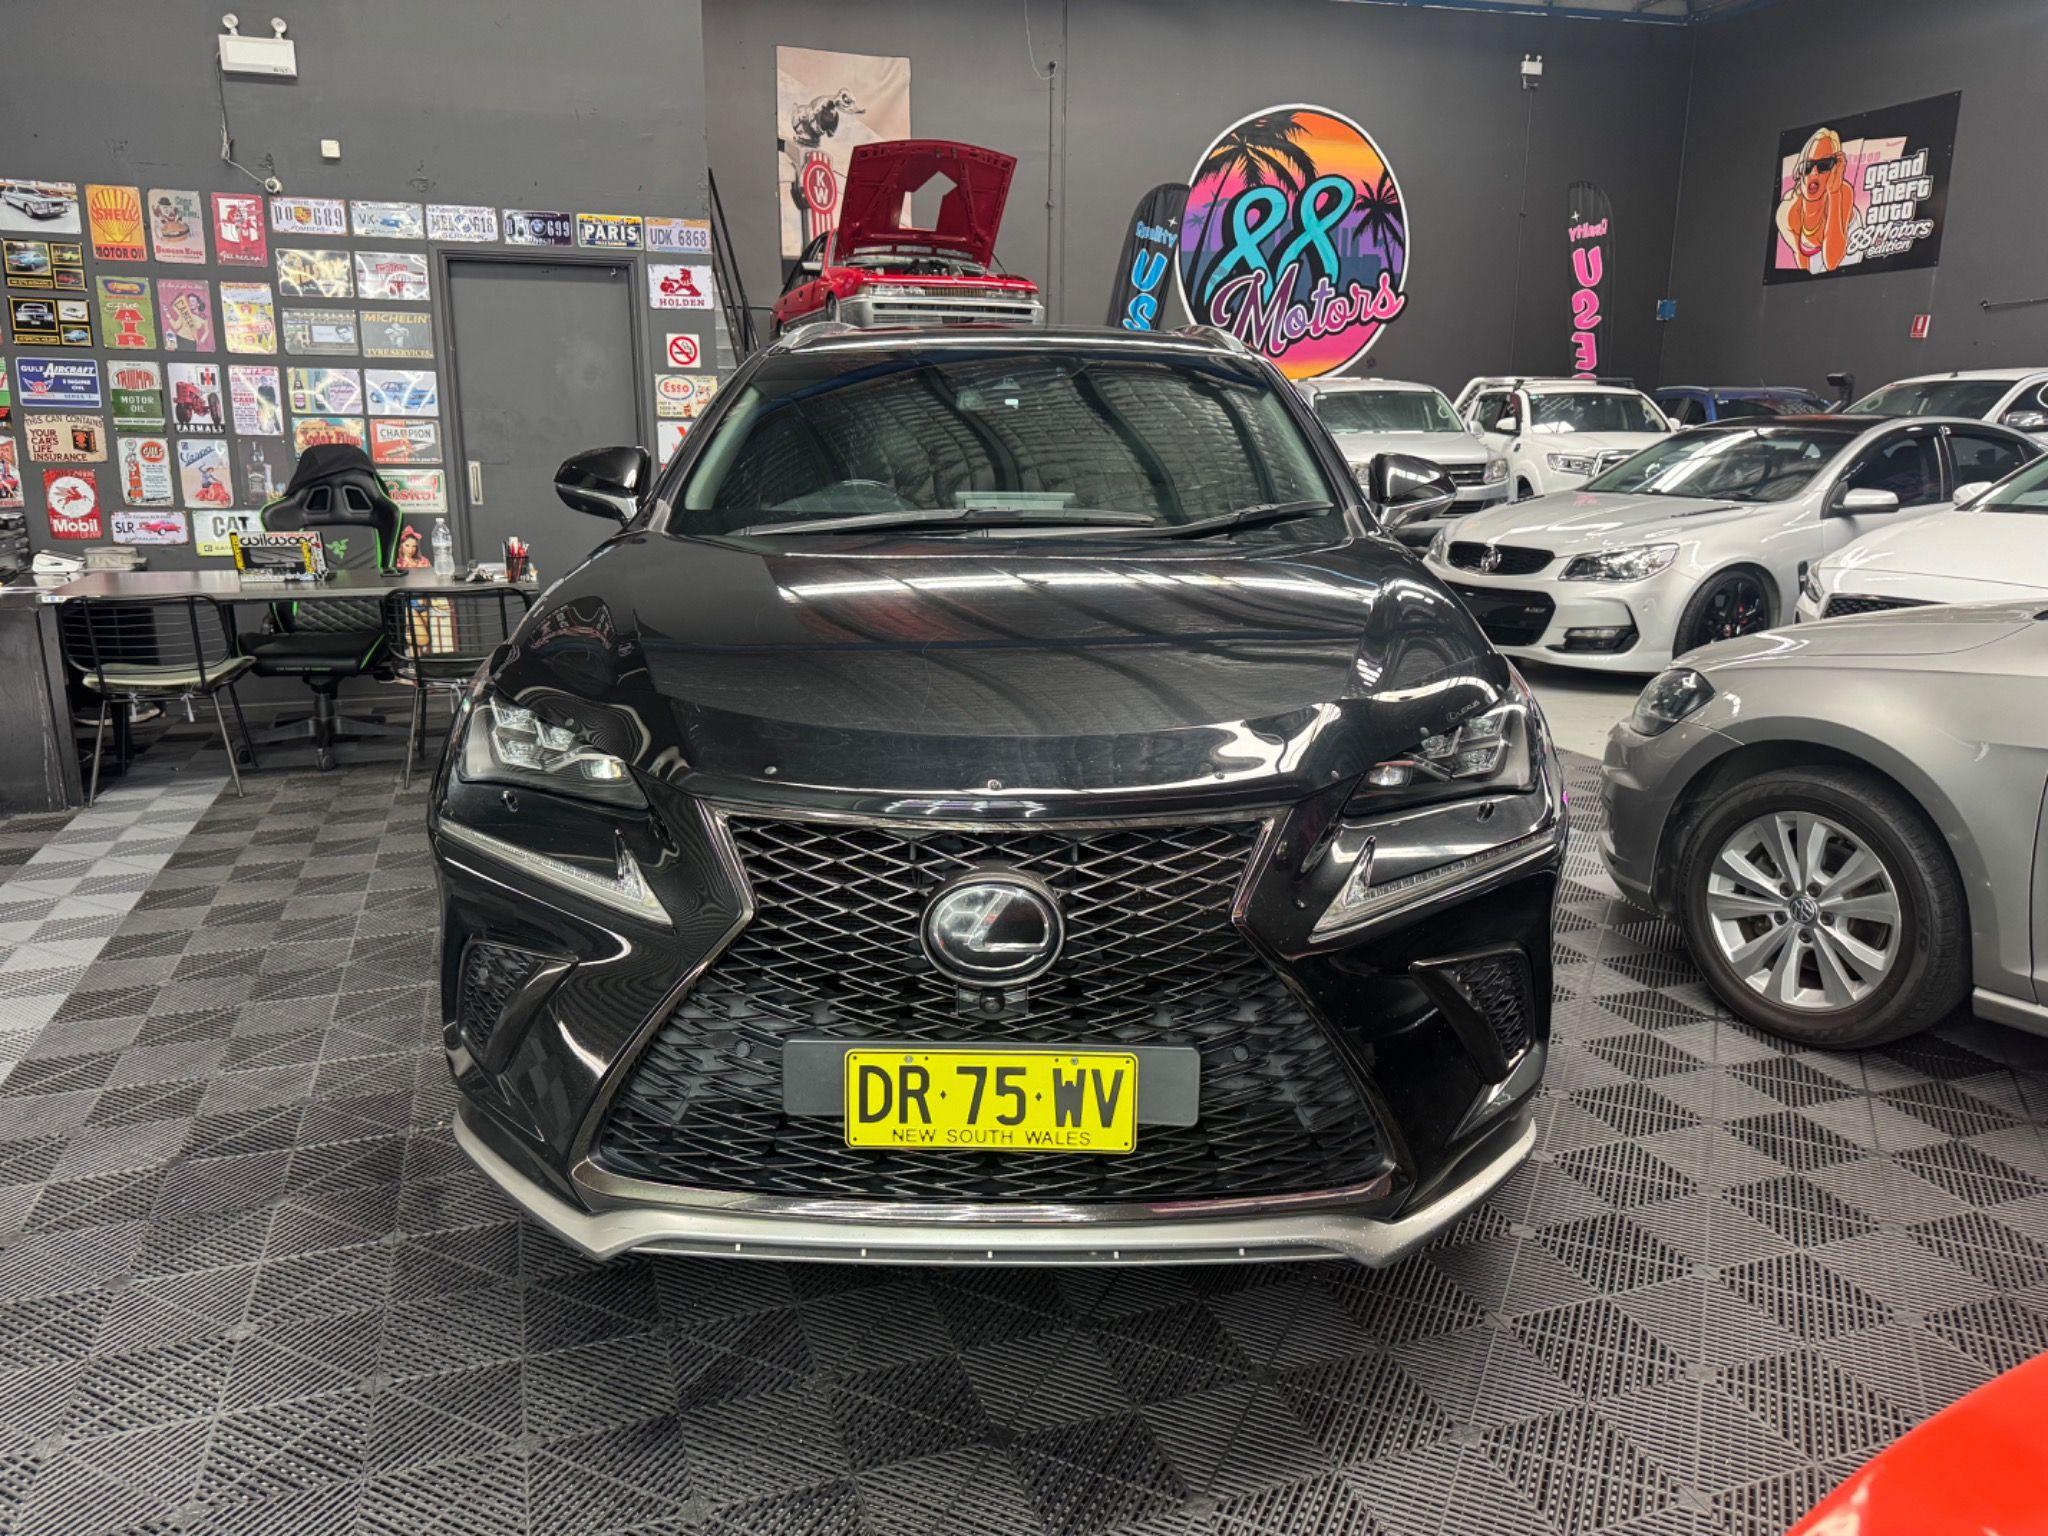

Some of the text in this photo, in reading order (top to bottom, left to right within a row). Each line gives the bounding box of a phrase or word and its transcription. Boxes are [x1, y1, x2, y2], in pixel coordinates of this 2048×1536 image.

[96, 208, 135, 220] SHELL
[313, 207, 343, 227] 689
[547, 220, 569, 237] 699
[584, 223, 637, 241] PARIS
[650, 228, 707, 247] UDK 6868
[1203, 173, 1354, 306] 88
[96, 246, 145, 259] MOTOR OIL
[1209, 262, 1403, 356] Motors
[364, 313, 428, 324] MICHELIN
[20, 363, 97, 378] GULF AIRCRAFT
[121, 396, 154, 404] MOTOR
[130, 405, 146, 413] OIL
[46, 415, 62, 423] CAN
[29, 429, 57, 438] YOUR
[176, 424, 224, 433] FARMALL
[379, 428, 431, 439] CHAMPION
[32, 445, 54, 453] LIFE
[33, 453, 88, 462] INSURANCE
[52, 519, 98, 532] Mobil
[115, 521, 135, 534] SLR
[212, 516, 249, 537] CAT
[892, 1129, 1091, 1146] NEW SOUTH WALES
